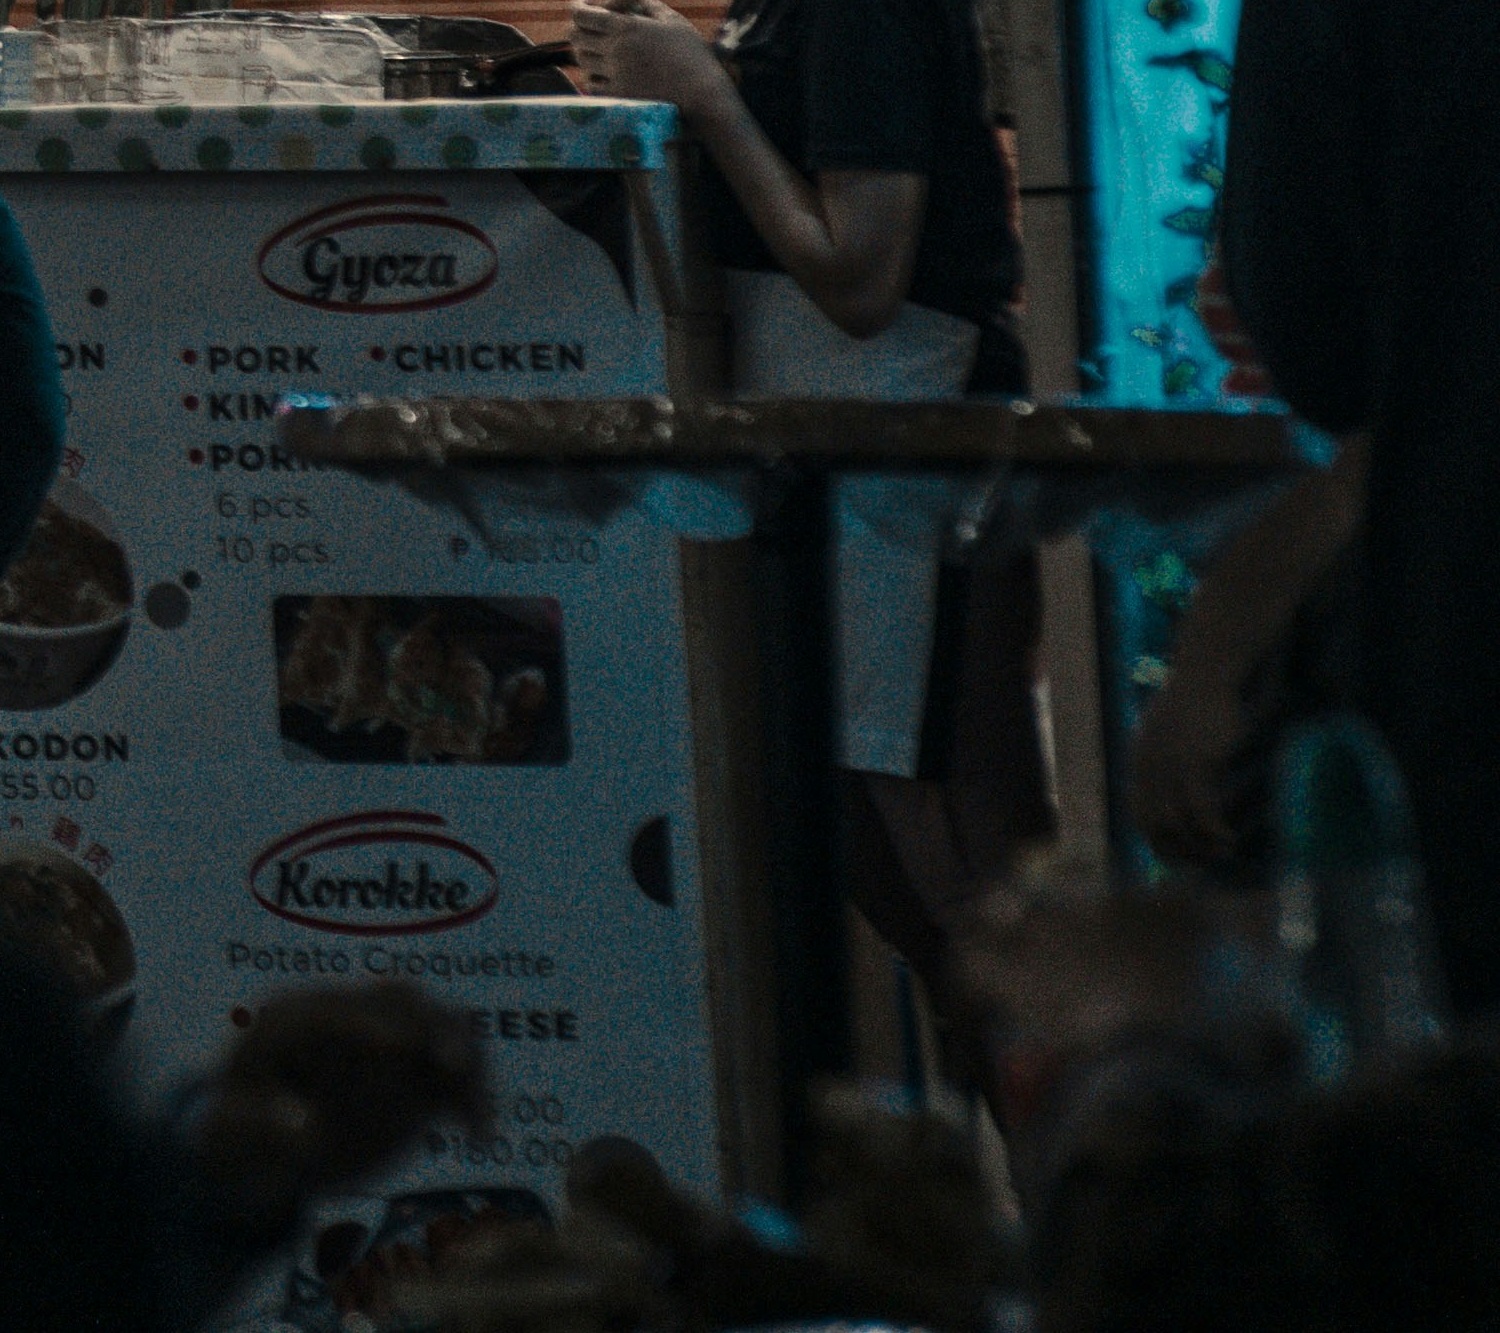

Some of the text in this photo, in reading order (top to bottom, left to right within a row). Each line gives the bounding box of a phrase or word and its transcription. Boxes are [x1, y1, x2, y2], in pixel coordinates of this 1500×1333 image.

[302, 235, 459, 303] Gyoza
[209, 343, 587, 375] PORK CHICKEN
[217, 492, 311, 527] 6 pcs
[216, 536, 329, 569] 10 pcs
[275, 860, 471, 911] Korokke
[228, 942, 557, 980] Potato Croquette
